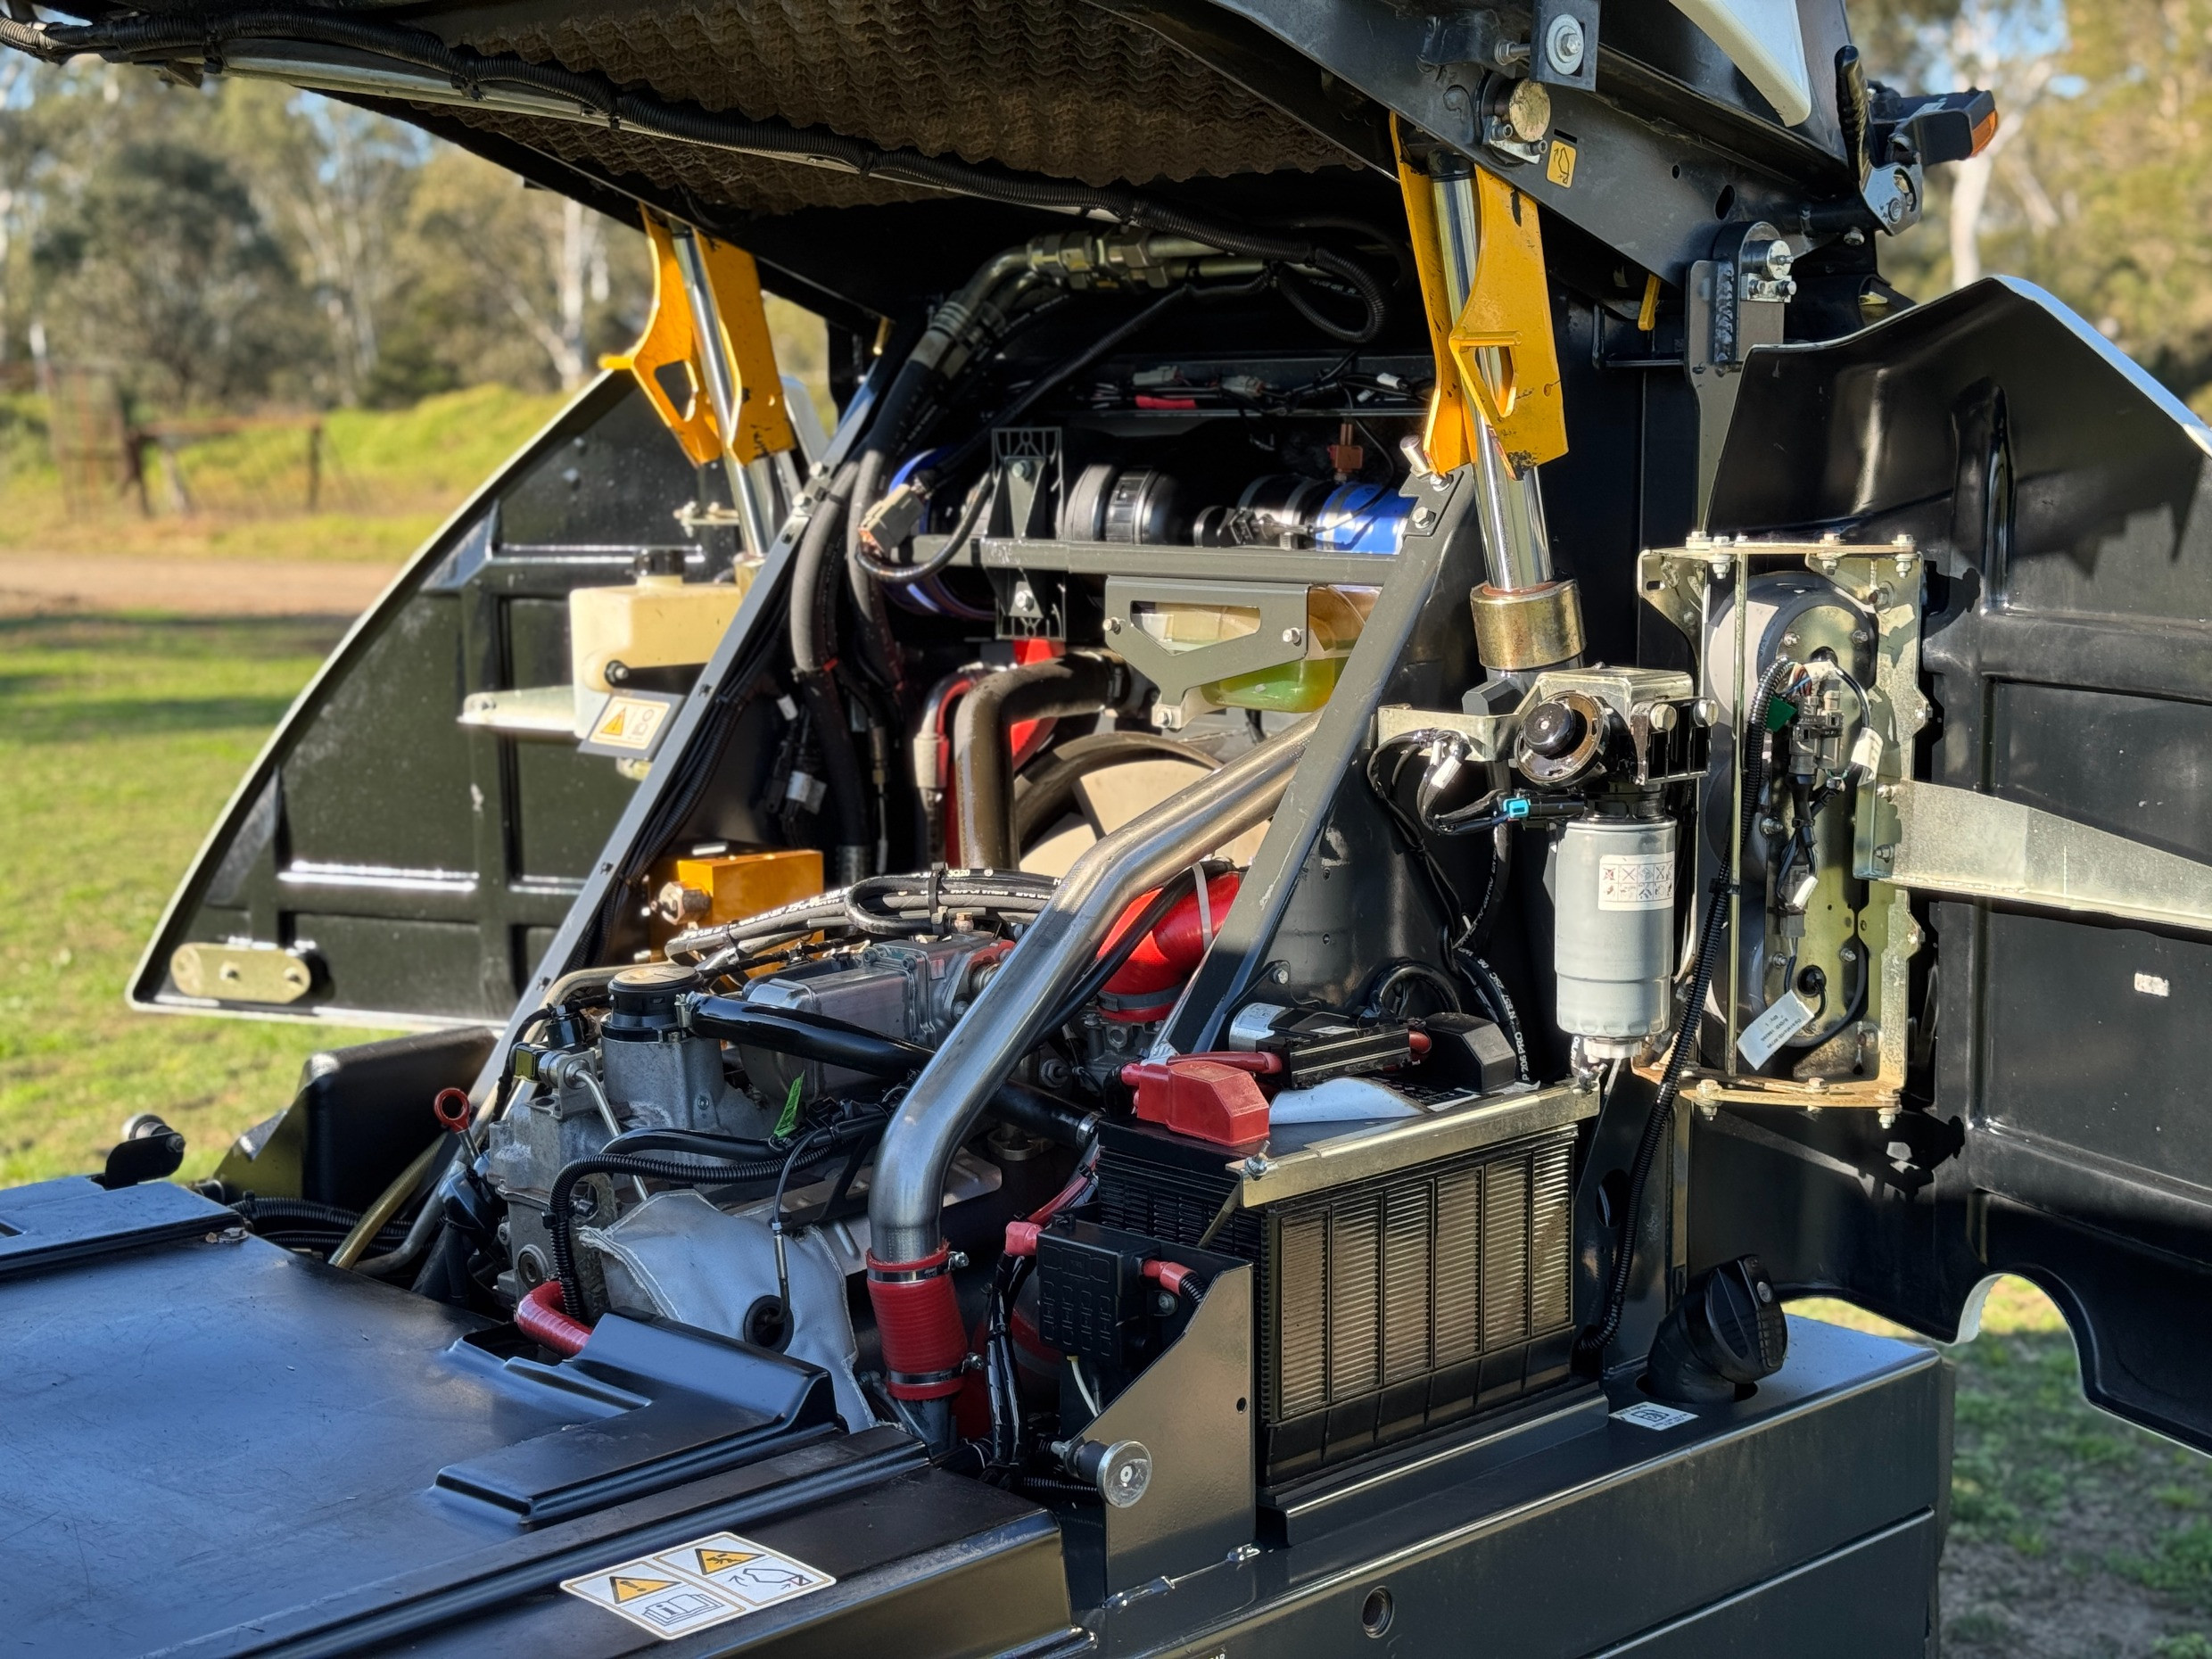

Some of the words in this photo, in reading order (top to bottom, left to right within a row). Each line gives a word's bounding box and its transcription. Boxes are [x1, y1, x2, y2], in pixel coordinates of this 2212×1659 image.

[1515, 1031, 1526, 1054] PRO
[1519, 1054, 1529, 1073] 206
[1522, 1073, 1530, 1082] P
